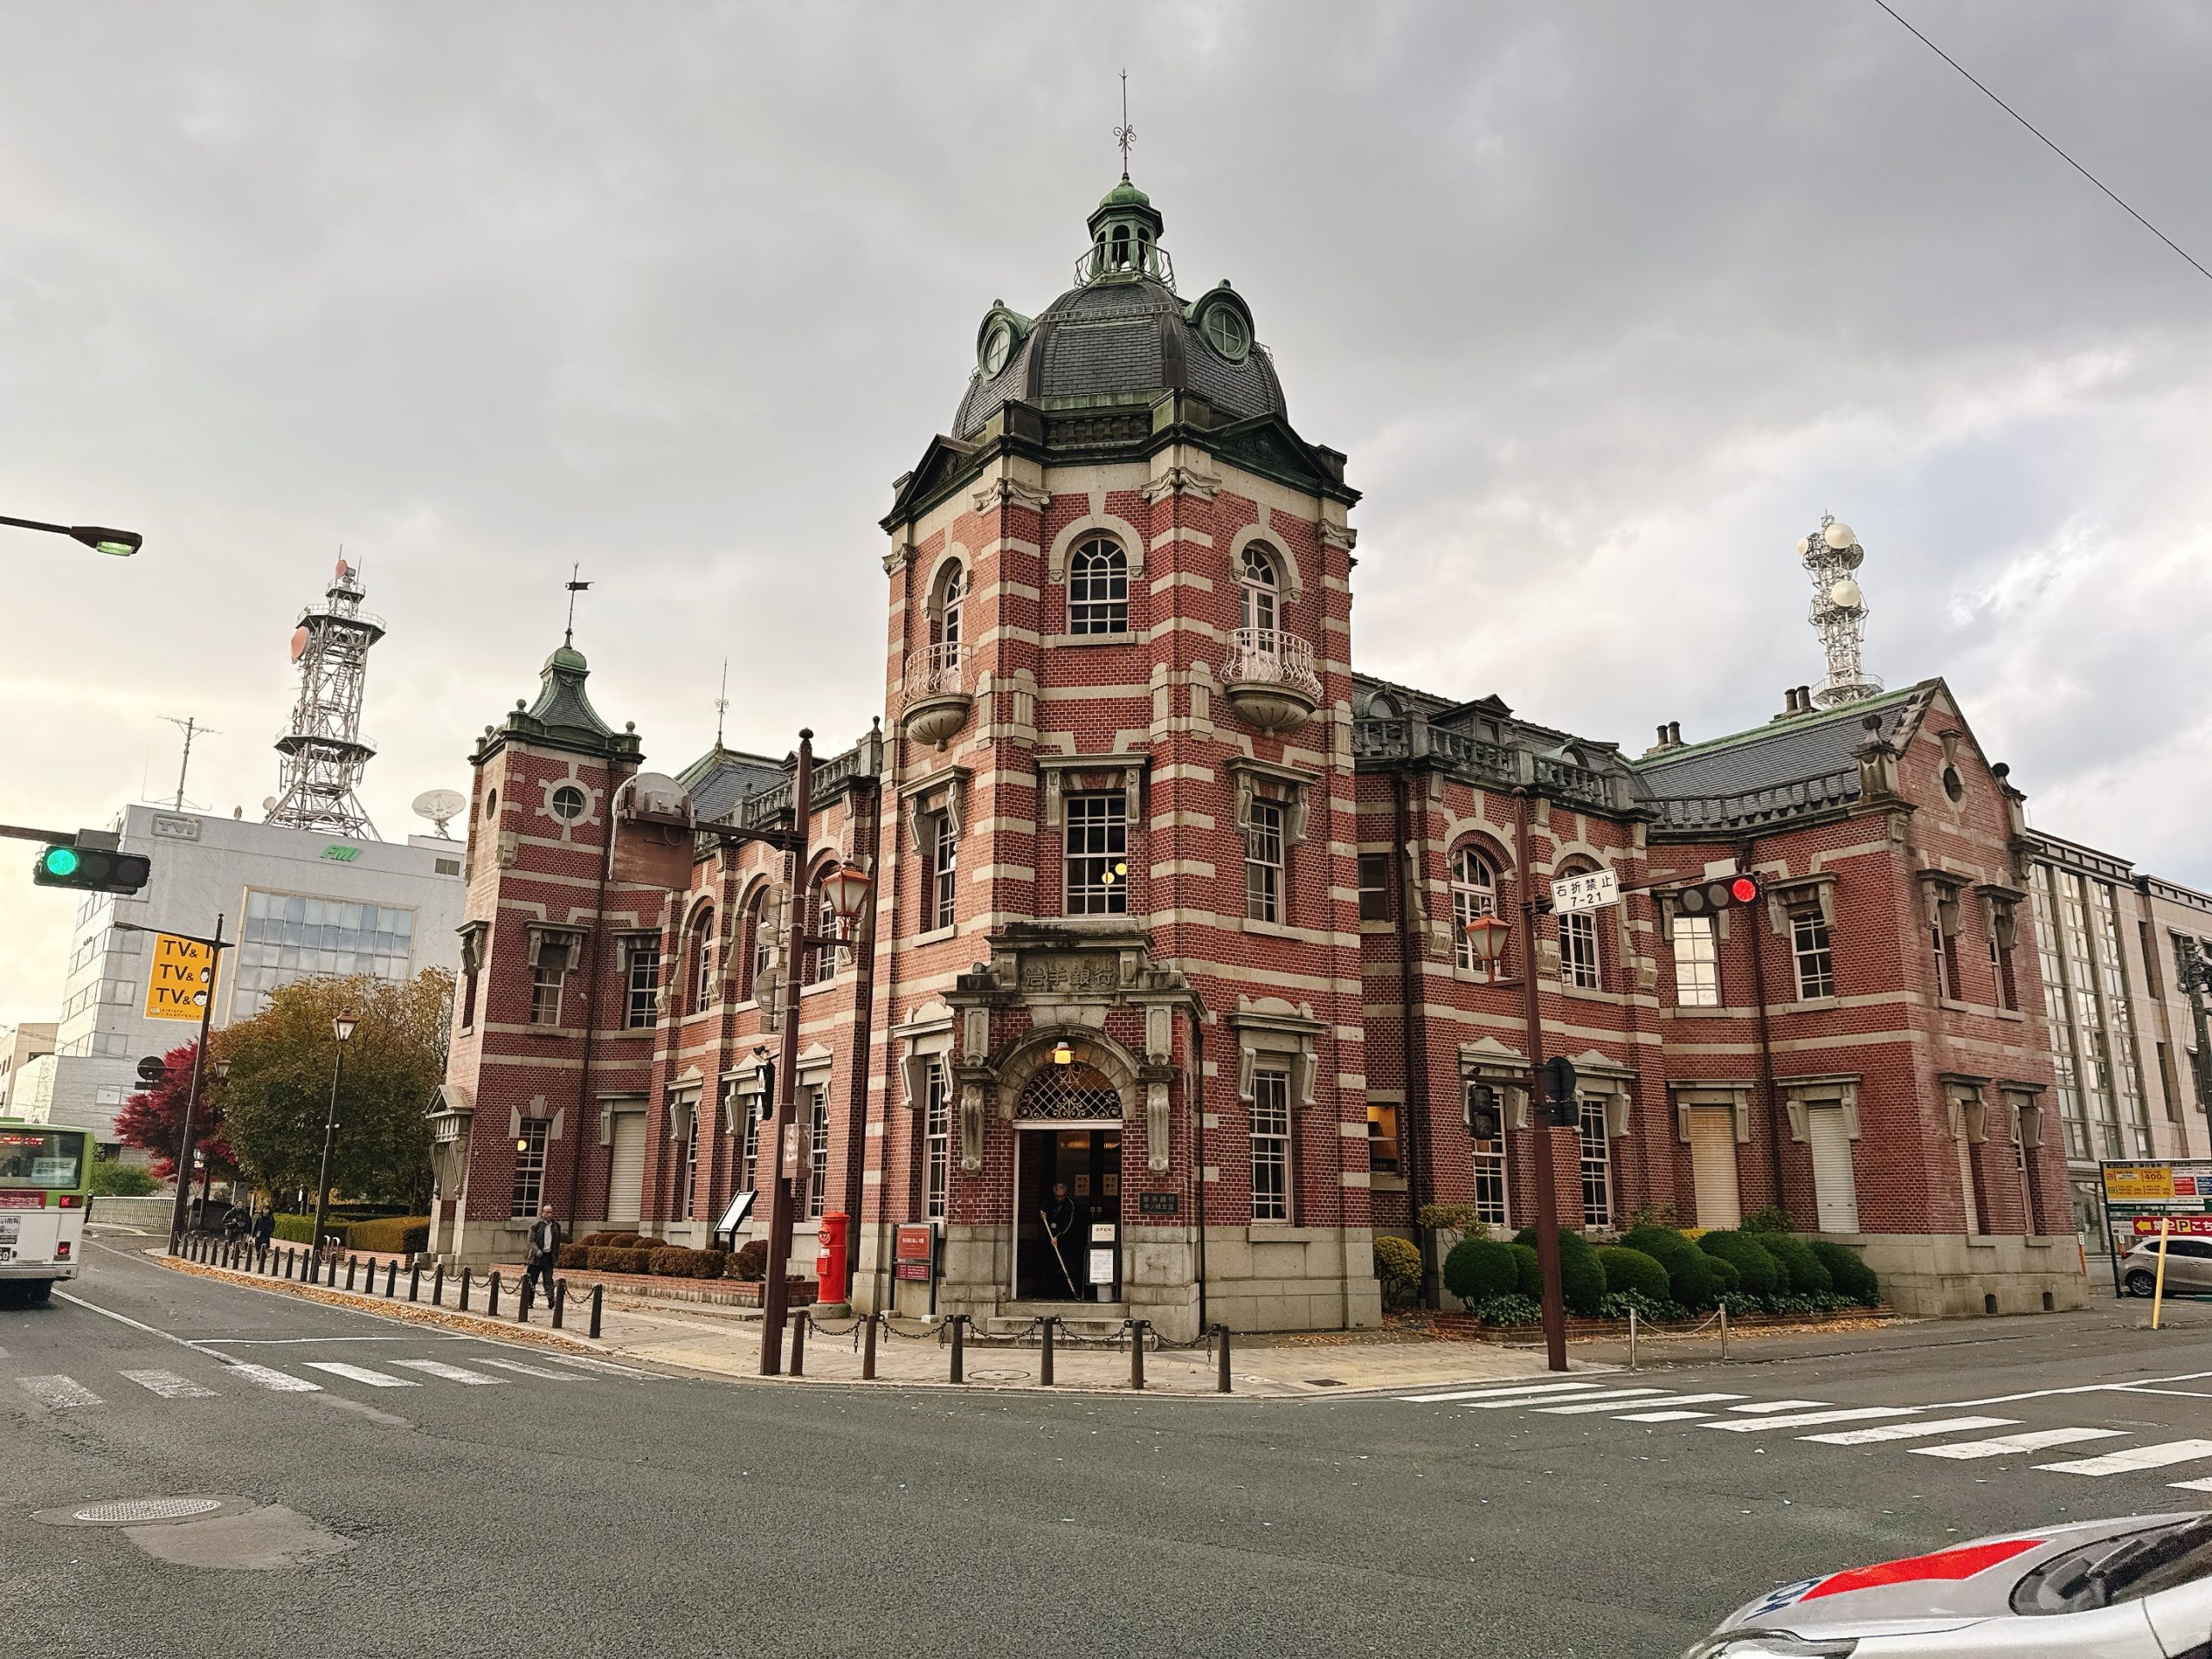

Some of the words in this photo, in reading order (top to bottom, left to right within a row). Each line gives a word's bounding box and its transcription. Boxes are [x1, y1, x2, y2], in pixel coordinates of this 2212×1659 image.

[1556, 875, 1612, 897] 右折禁止
[1571, 892, 1601, 906] 7-21
